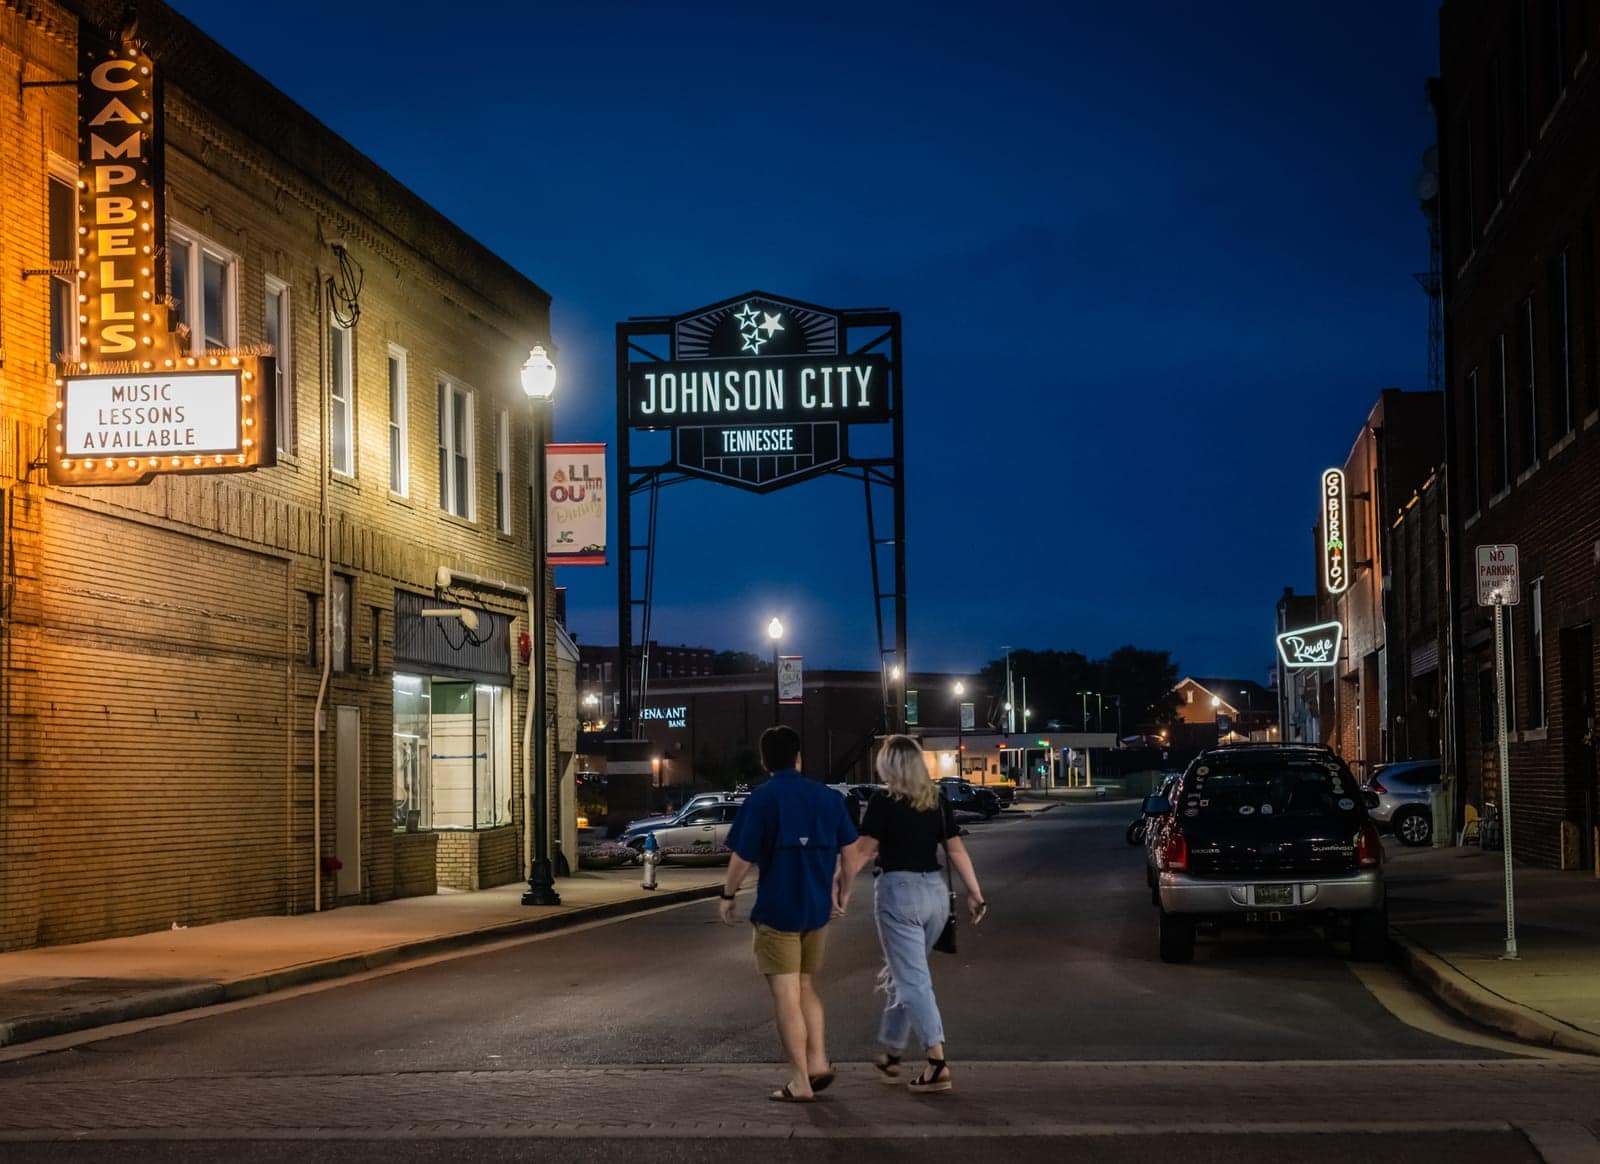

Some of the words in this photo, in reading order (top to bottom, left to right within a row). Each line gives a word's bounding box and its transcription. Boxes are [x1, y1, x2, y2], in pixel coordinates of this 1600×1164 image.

[89, 60, 143, 354] CAMPBELLS
[112, 383, 171, 402] MUSIC
[641, 368, 784, 414] JOHNSON
[801, 366, 873, 408] CITY
[98, 406, 185, 426] LESSONS
[84, 428, 195, 449] AVAILABLE
[722, 429, 793, 452] TENNESSEE
[1326, 473, 1339, 497] GO
[1489, 550, 1504, 562] NO
[1480, 565, 1515, 577] PARKING
[1285, 636, 1333, 662] Rouge
[668, 720, 686, 728] BANK
